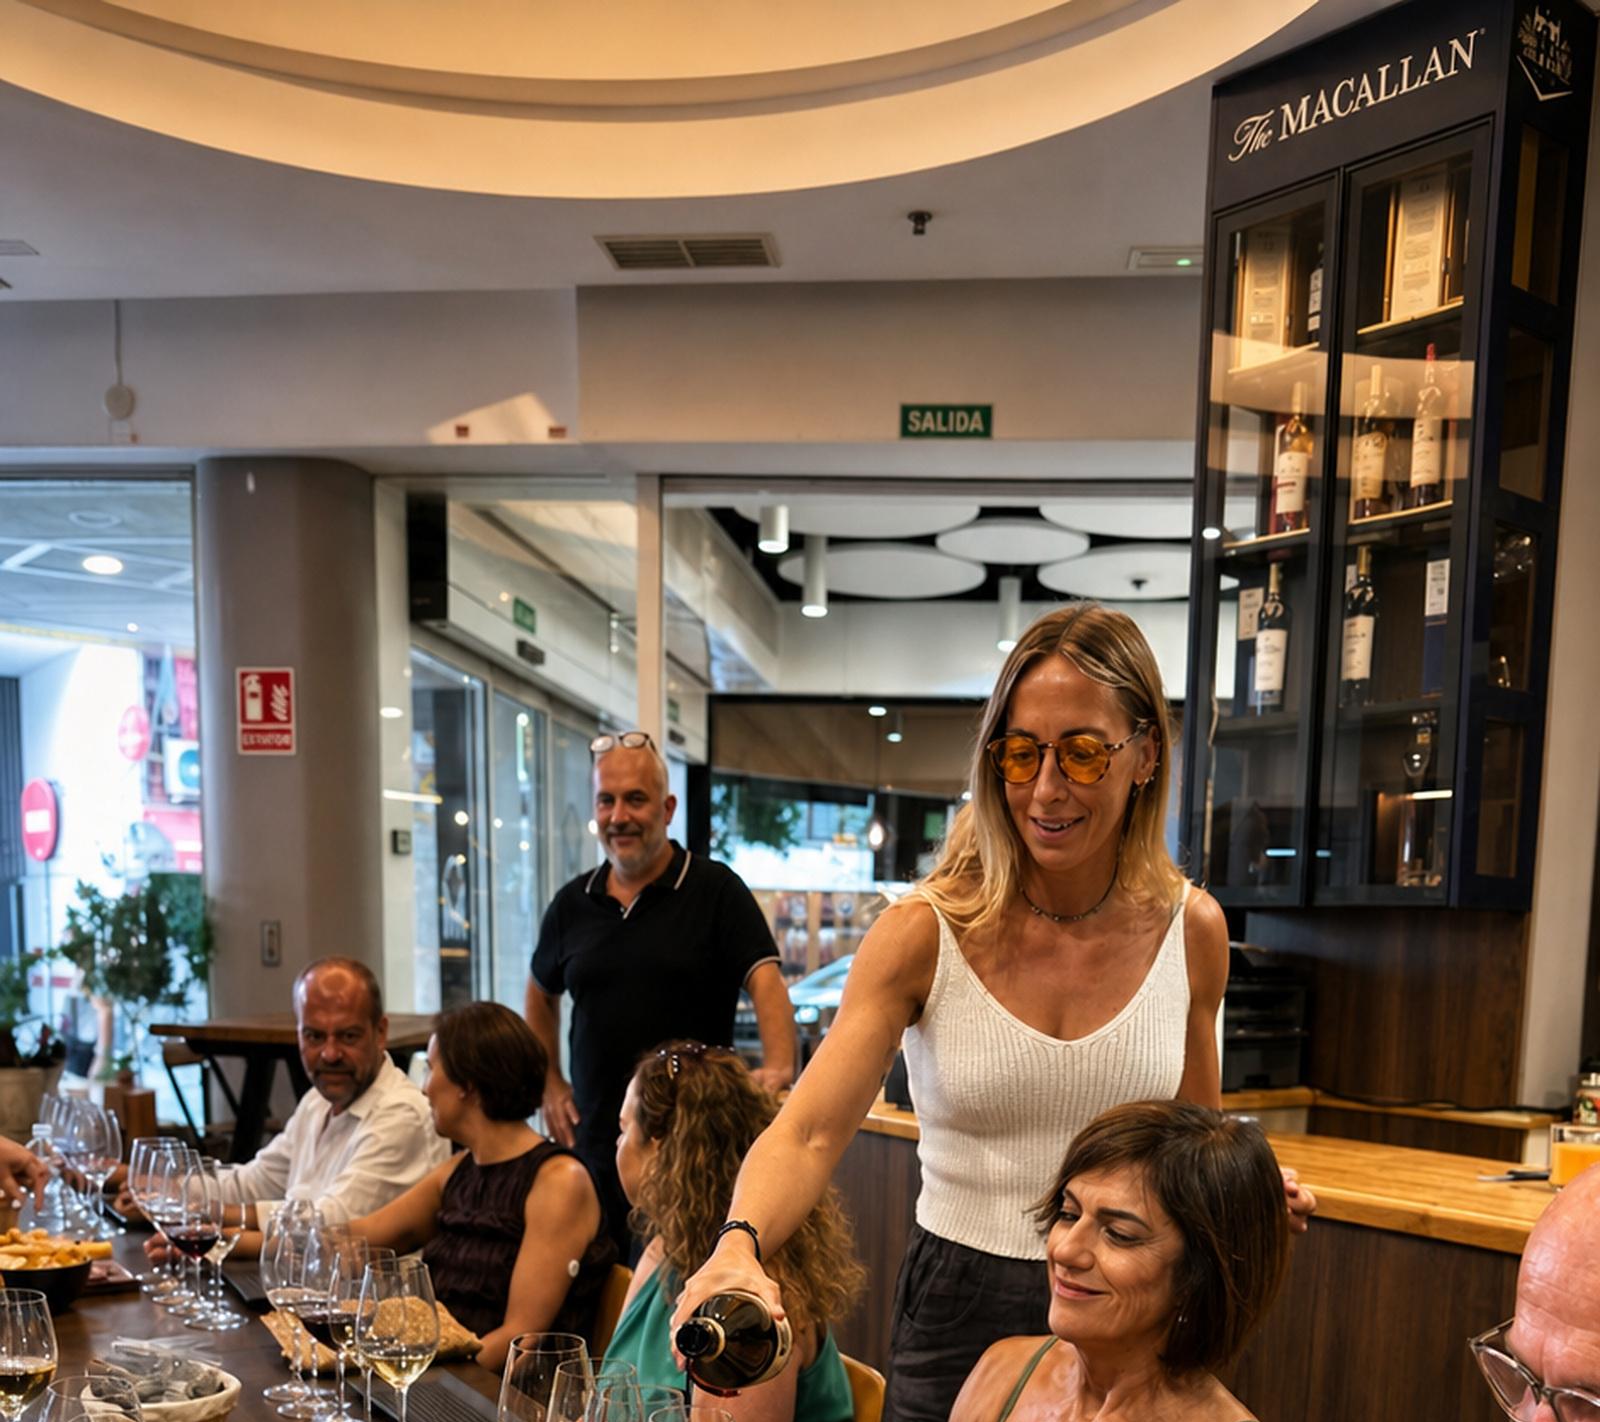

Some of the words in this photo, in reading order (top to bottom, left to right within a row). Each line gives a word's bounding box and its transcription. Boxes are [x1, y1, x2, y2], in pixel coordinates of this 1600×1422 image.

[1228, 109, 1275, 162] The
[1278, 30, 1478, 141] MACALLAN
[907, 410, 984, 433] SALIDA
